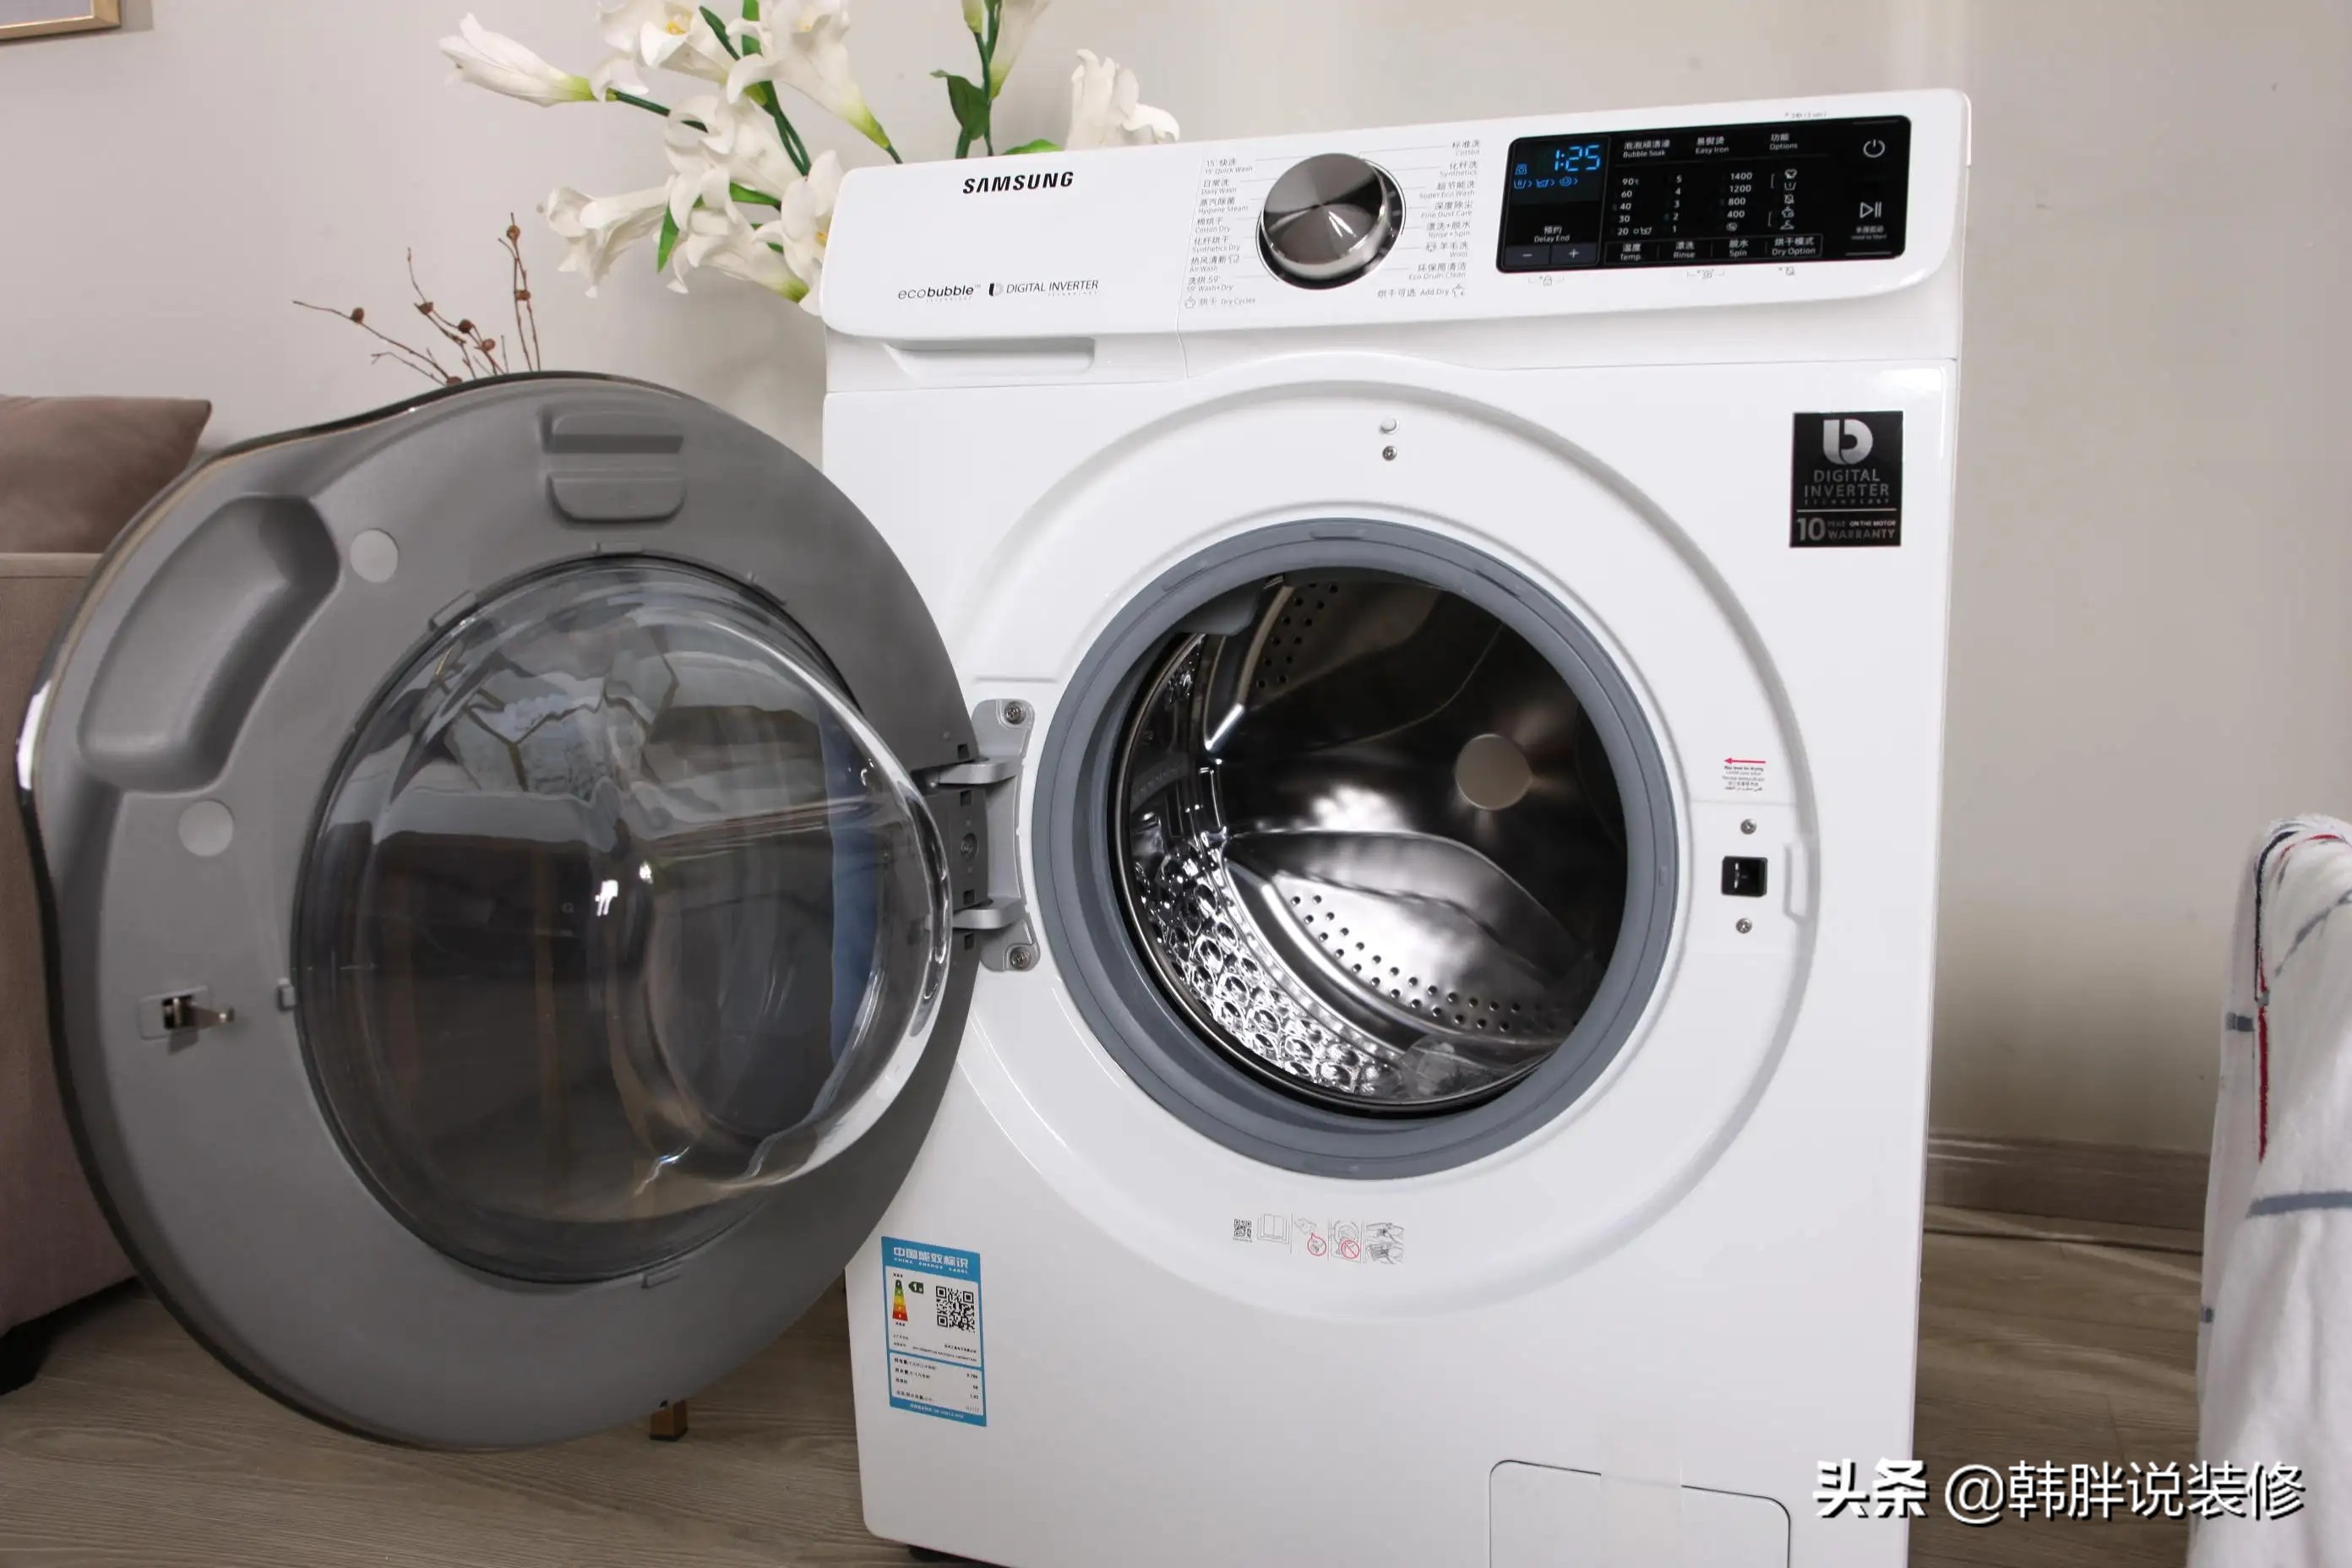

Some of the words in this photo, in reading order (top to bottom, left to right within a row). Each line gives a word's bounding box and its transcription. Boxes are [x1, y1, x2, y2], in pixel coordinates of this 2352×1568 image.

[1623, 150, 1647, 159] Bubble
[1695, 147, 1712, 155] Easy
[1554, 144, 1601, 172] 1:25
[1439, 170, 1478, 178] Synthetics
[1676, 174, 1683, 183] 5
[1730, 172, 1753, 181] 1400
[962, 171, 1075, 194] SAMSUNG
[1674, 187, 1681, 195] 4
[1729, 184, 1752, 193] 1200
[1621, 190, 1633, 199] 60
[1674, 199, 1680, 209] 3
[1728, 198, 1746, 206] 800
[1619, 215, 1631, 223] 30
[1673, 212, 1679, 221] 2
[1727, 210, 1745, 219] 400
[1617, 227, 1629, 236] 20
[1534, 235, 1554, 243] Delay
[1774, 237, 1815, 247] 烘干模式
[1192, 245, 1228, 253] Synthetics
[1228, 243, 1240, 252] Dry
[1772, 248, 1787, 257] Dry
[1788, 247, 1816, 256] Option
[1673, 251, 1696, 259] Rinse
[1729, 248, 1748, 258] Spin
[1006, 282, 1047, 294] DIGITAL
[1048, 280, 1099, 292] INVERTER
[1436, 288, 1450, 297] Dry
[1813, 469, 1881, 482] DIGITAL
[1805, 483, 1890, 498] INVERTER
[1797, 517, 1826, 542] 10
[1827, 529, 1896, 540] WARRANTY
[893, 1247, 969, 1268] 中国能效标识
[918, 1261, 944, 1270] ENERGY
